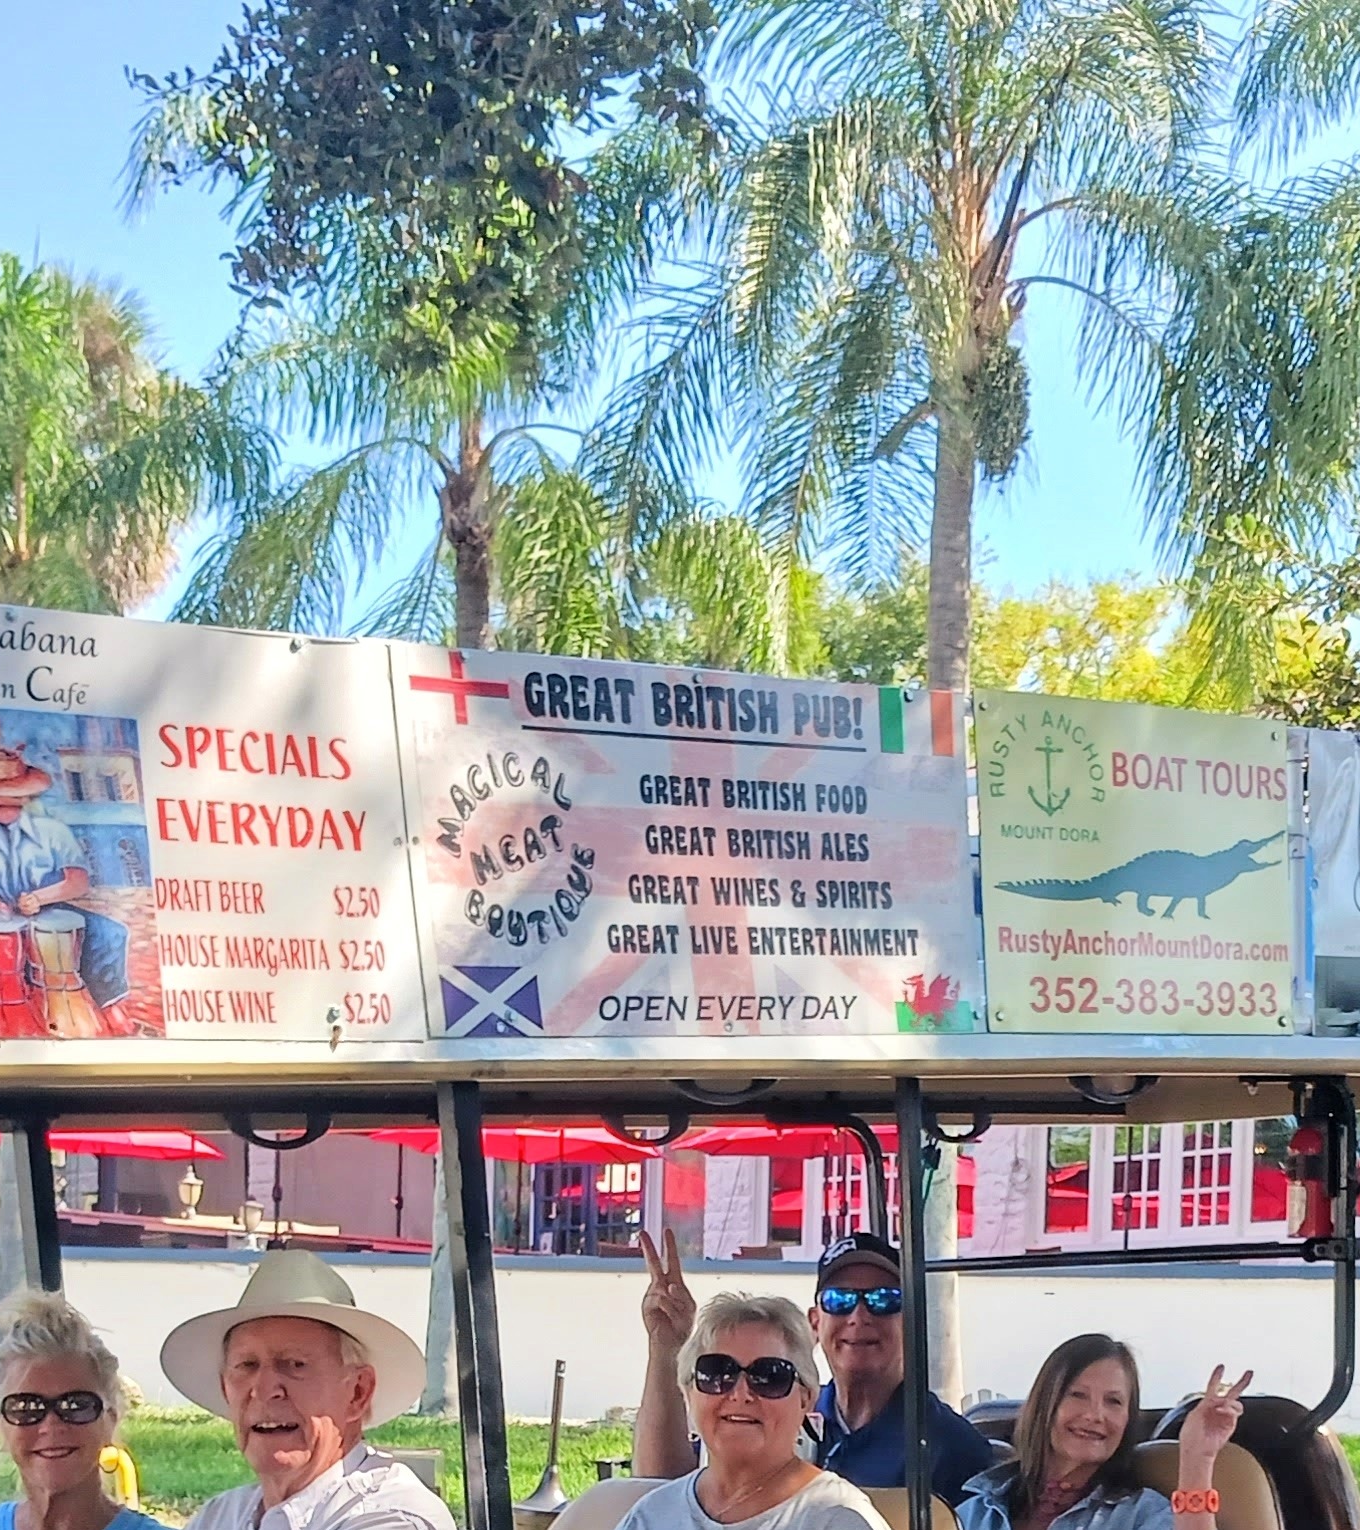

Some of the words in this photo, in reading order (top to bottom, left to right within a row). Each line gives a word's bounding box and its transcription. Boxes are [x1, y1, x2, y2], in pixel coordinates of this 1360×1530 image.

[524, 672, 635, 724] GREAT
[792, 693, 864, 741] PUB!
[158, 723, 352, 781] SPECIALS
[988, 714, 1027, 798] RUSTY
[1041, 709, 1106, 803] ANCHOR
[639, 774, 711, 808] GREAT
[721, 778, 807, 812] BRITISH
[815, 784, 867, 815] FOOD
[1112, 751, 1187, 793] BOAT
[1196, 759, 1287, 801] TOURS
[156, 797, 366, 851] EVERYDAY
[436, 752, 572, 859] MAGICAL
[470, 814, 563, 886] MEAT
[645, 824, 716, 856] GREAT
[726, 827, 811, 861] BRITISH
[821, 832, 870, 862] ALES
[1001, 823, 1054, 840] MOUNT
[1059, 827, 1100, 842] DORA
[155, 878, 213, 911] DRAFT
[220, 880, 265, 914] BEER
[333, 885, 380, 918] $2.50
[464, 843, 596, 947] BOUTIQUE
[628, 874, 700, 906] GREAT
[710, 877, 781, 908] WINES
[790, 879, 806, 908] &
[816, 880, 893, 910] SPIRITS
[160, 934, 219, 968] HOUSE
[225, 936, 330, 977] MARGARITA
[339, 940, 385, 972] $2.50
[607, 924, 680, 955] GREAT
[689, 925, 739, 955] LIVE
[748, 926, 918, 957] ENTERTAINMENT
[998, 926, 1289, 962] RustyAnchorMountDora.com
[165, 989, 226, 1023] HOUSE
[228, 990, 277, 1024] WINE
[344, 991, 391, 1025] $2.50
[599, 995, 689, 1022] OPEN
[696, 995, 798, 1022] EVERY
[802, 995, 857, 1021] DAY
[1029, 976, 1278, 1017] 352-383-3933
